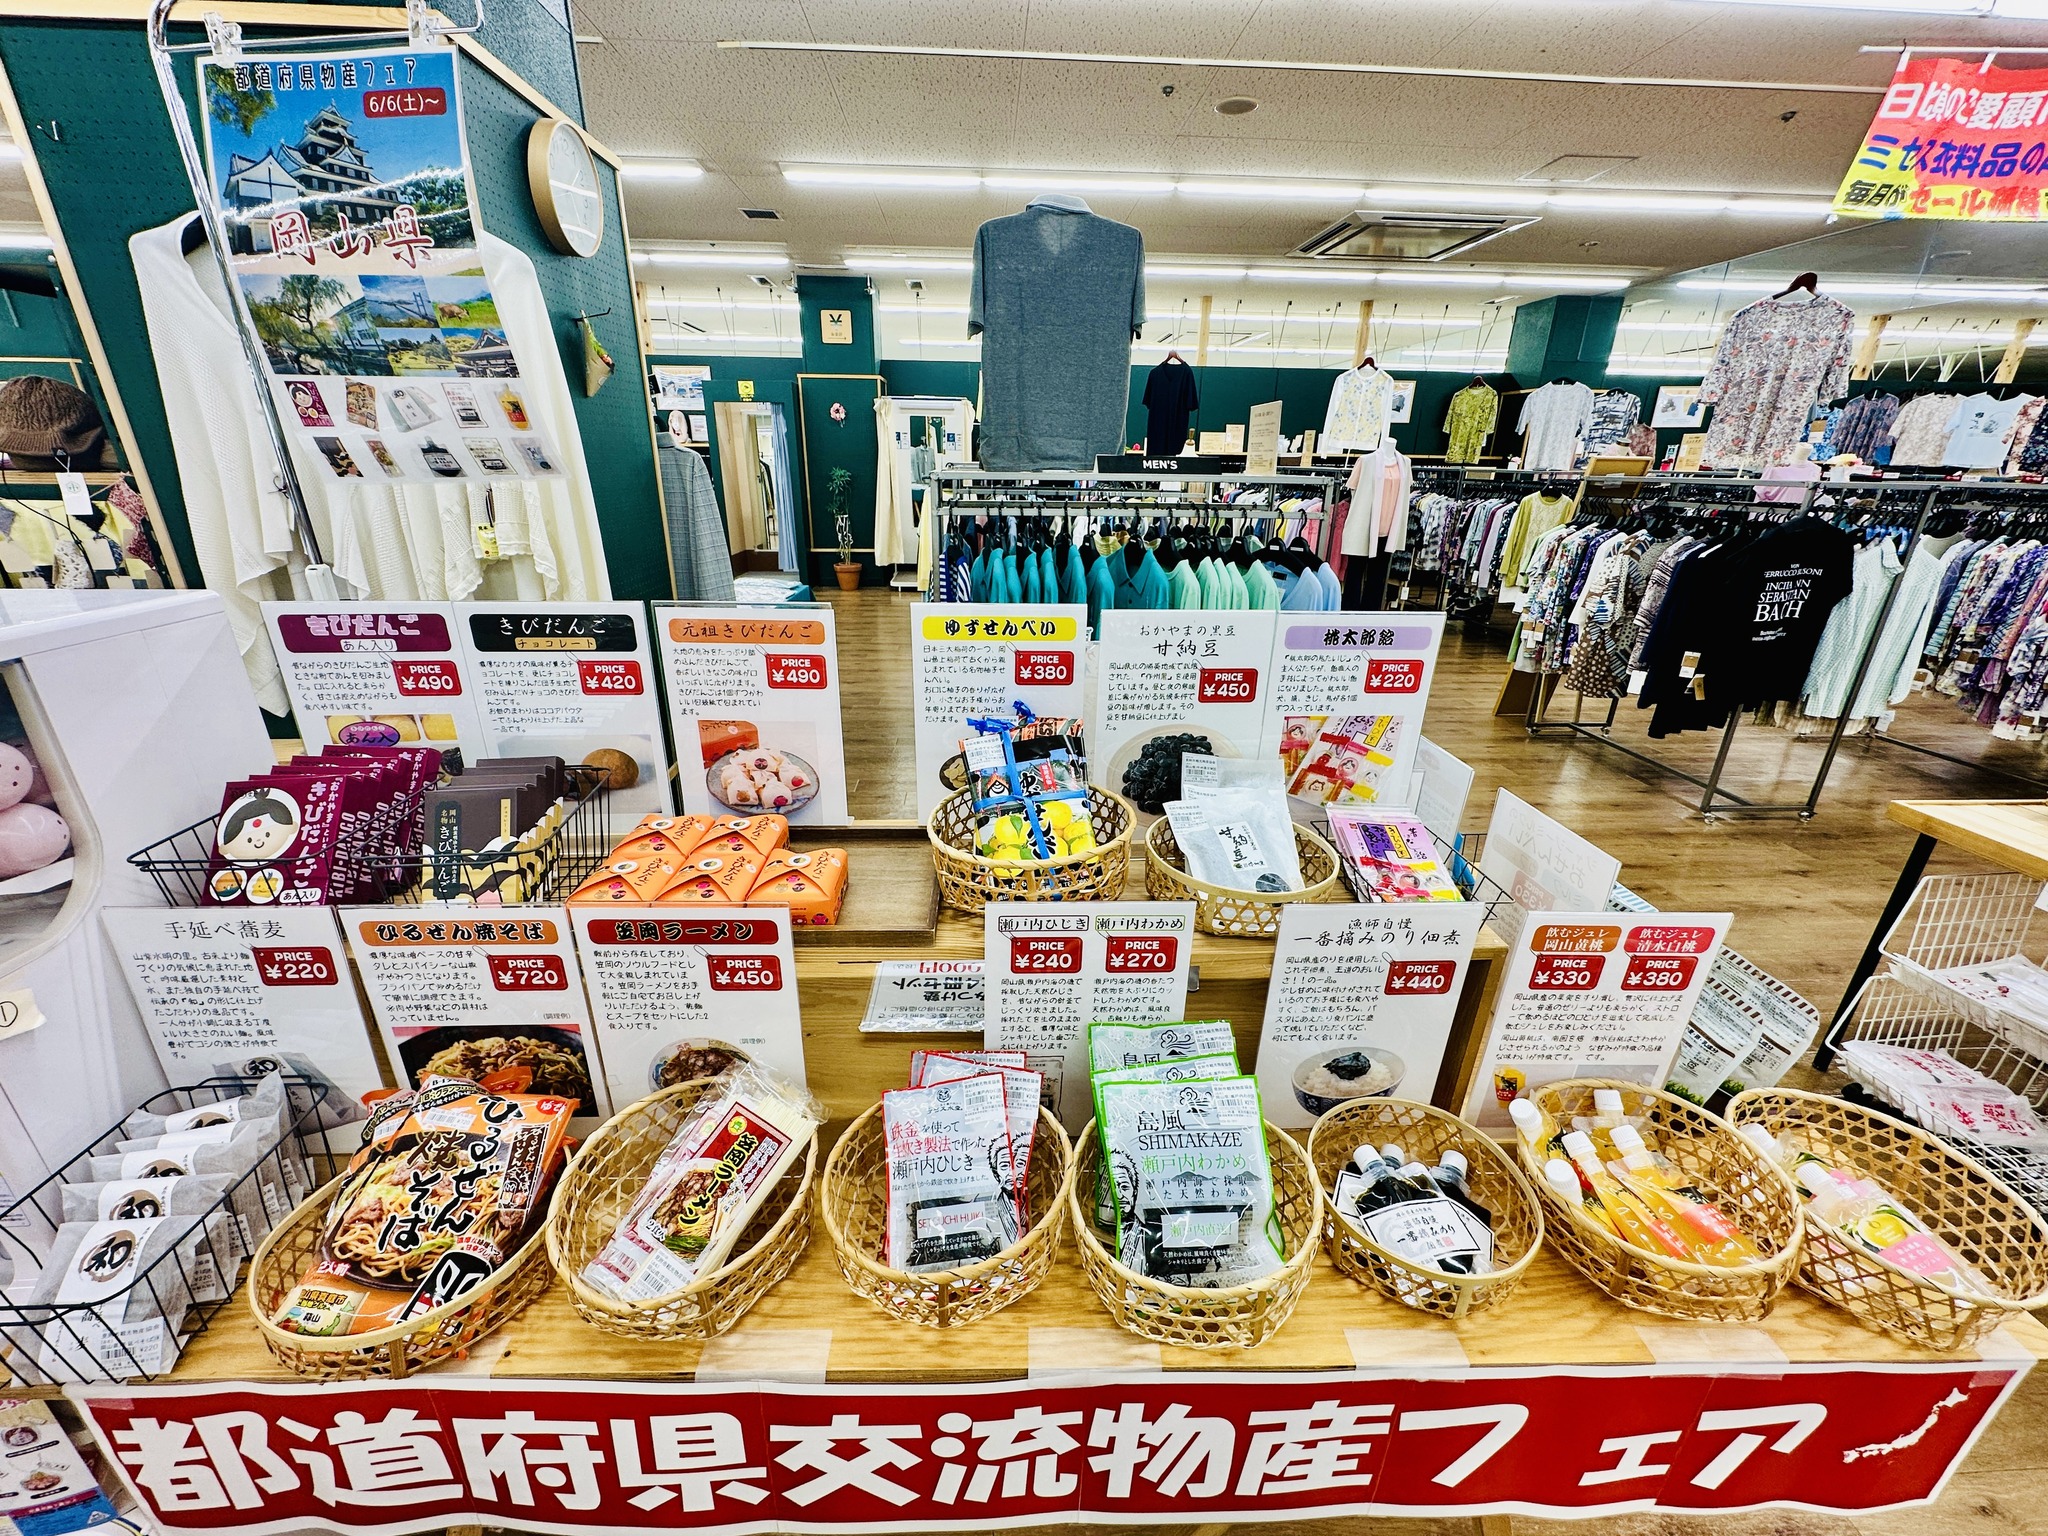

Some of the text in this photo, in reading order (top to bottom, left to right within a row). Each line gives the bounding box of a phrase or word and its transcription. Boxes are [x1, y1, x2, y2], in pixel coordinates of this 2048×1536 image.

[234, 57, 417, 92] 都道府県物産フェア
[1878, 81, 2048, 130] 日頃のご愛顧
[271, 205, 434, 269] 岡山県
[1142, 460, 1178, 470] MEN'S
[305, 615, 421, 636] きびだんご
[500, 617, 607, 635] きびだんご
[682, 623, 812, 638] 元祖きびだんご
[945, 620, 1056, 636] ゆずせんべい
[1140, 625, 1236, 637] おかやまの黒豆
[518, 639, 594, 648] チョコレート
[1323, 629, 1395, 646] 桃太郎飴
[343, 640, 394, 651] あん入り
[1152, 639, 1219, 657] 甘納豆
[782, 659, 811, 667] PRICE
[1031, 656, 1059, 664] PRICE
[410, 665, 441, 674] PRICE
[595, 665, 625, 674] PRICE
[1020, 666, 1067, 680] ¥380
[1382, 664, 1409, 672] PRICE
[402, 676, 453, 690] ¥490
[586, 676, 636, 690] ¥420
[772, 670, 820, 683] ¥490
[1215, 673, 1243, 681] PRICE
[1370, 674, 1415, 688] ¥220
[1204, 684, 1250, 697] ¥450
[165, 921, 286, 939] 手延べ蕎麦
[1000, 918, 1087, 931] 瀬戸内ひじき
[1096, 917, 1183, 930] 瀬戸内わかめ
[1349, 918, 1413, 930] 漁師自慢
[375, 923, 544, 941] ひるぜん焼そば
[615, 922, 753, 941] 笠岡ラーメン
[1294, 931, 1461, 946] 一番摘みのり佃煮
[1545, 927, 1610, 938] 飲むジュレ
[1638, 928, 1704, 939] 飲むジュレ
[1029, 941, 1065, 951] PRICE
[1125, 941, 1160, 949] PRICE
[1543, 939, 1604, 952] 岡山黄桃
[1636, 940, 1697, 952] 清水白桃
[274, 952, 313, 961] PRICE
[1015, 954, 1072, 969] ¥240
[1110, 953, 1167, 968] ¥270
[1552, 959, 1587, 968] PRICE
[265, 963, 328, 978] ¥220
[508, 960, 545, 968] PRICE
[726, 960, 762, 968] PRICE
[1406, 965, 1439, 973] PRICE
[1646, 960, 1680, 969] PRICE
[498, 970, 558, 985] ¥720
[716, 971, 774, 985] ¥450
[1391, 975, 1445, 989] ¥440
[1534, 970, 1592, 985] ¥330
[1627, 971, 1684, 986] ¥380
[1137, 1109, 1186, 1132] 島風
[1138, 1131, 1243, 1150] SHIMAKAZE
[431, 1095, 522, 1235] ひるぜん
[893, 1154, 973, 1180] 瀬戸内ひじき
[1141, 1153, 1247, 1174] 瀬戸内わかめ
[379, 1130, 466, 1253] 焼そば
[83, 1237, 129, 1273] 和
[116, 1400, 1828, 1514] 都道府県交流物産フェア
